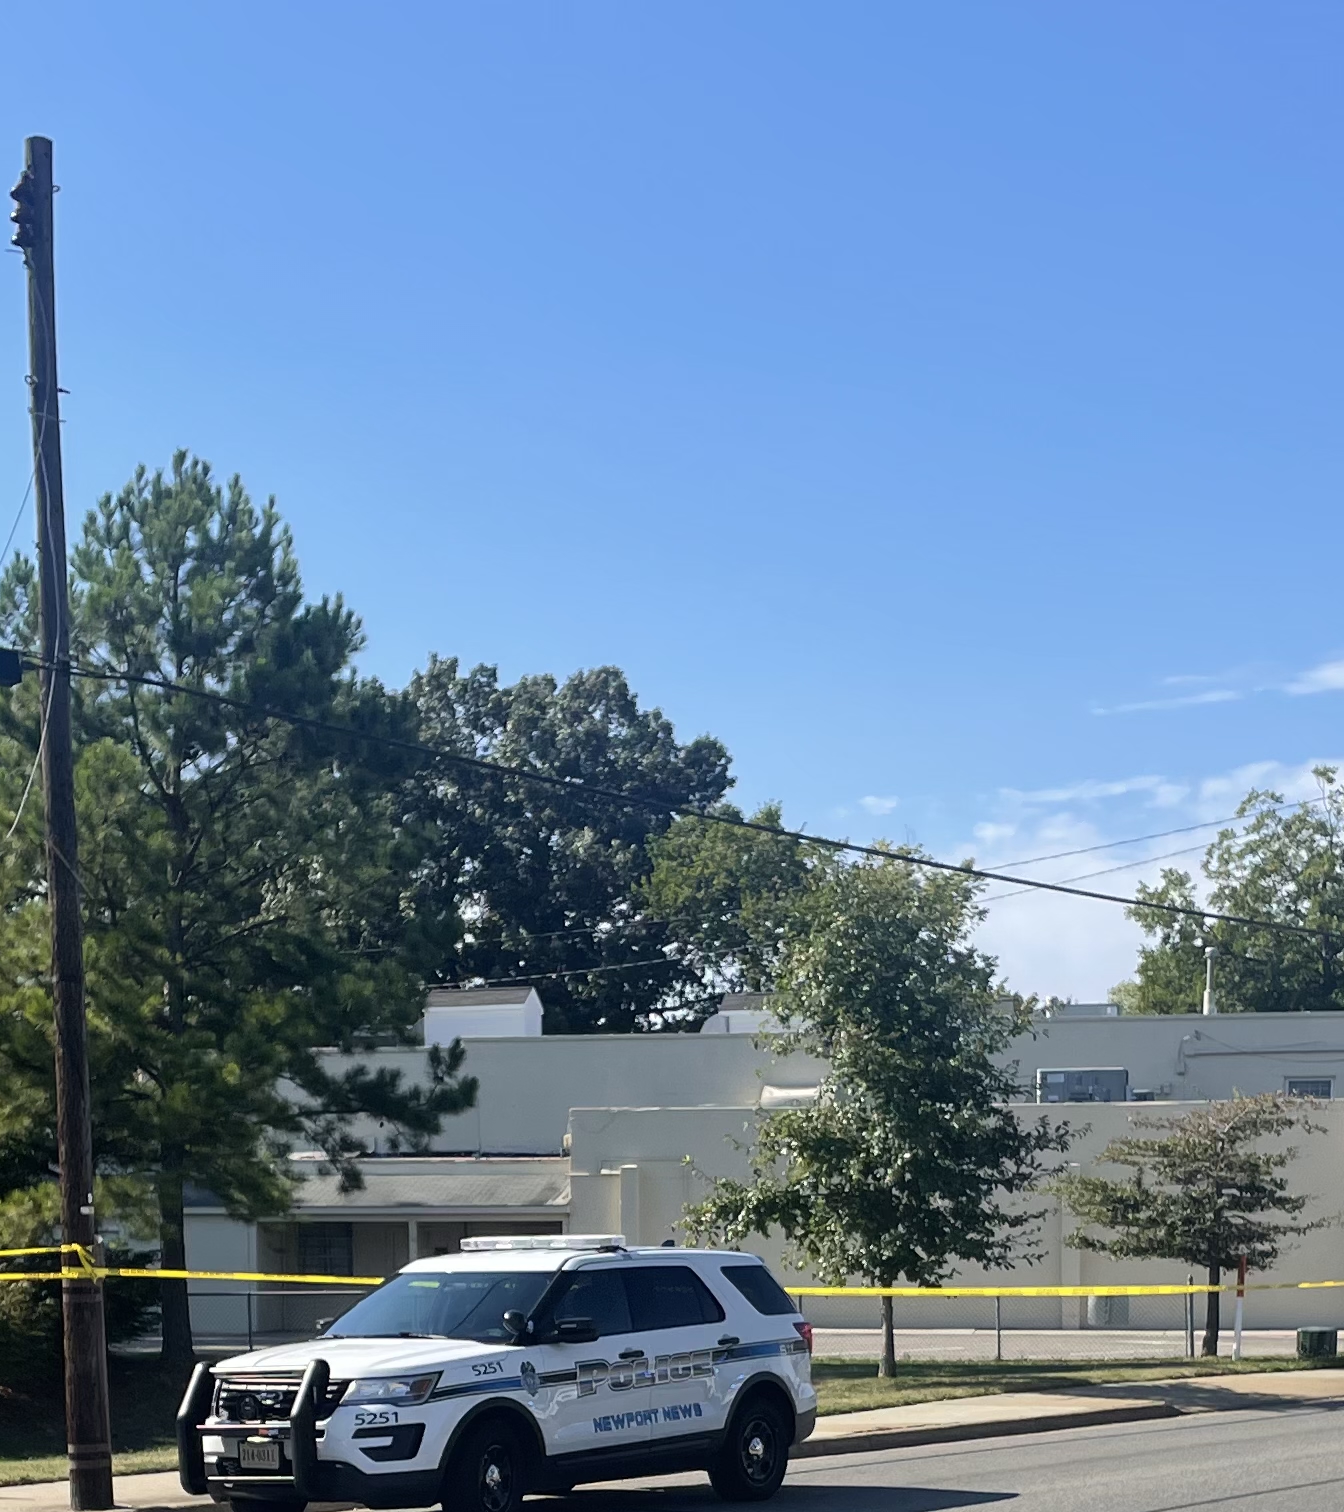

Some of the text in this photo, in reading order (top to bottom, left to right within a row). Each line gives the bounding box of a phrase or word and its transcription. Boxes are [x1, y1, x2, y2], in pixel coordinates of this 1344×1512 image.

[471, 1361, 504, 1376] 5251
[574, 1352, 714, 1398] POLICE
[354, 1411, 399, 1427] 5251
[592, 1402, 703, 1433] NEWPORT NEWS
